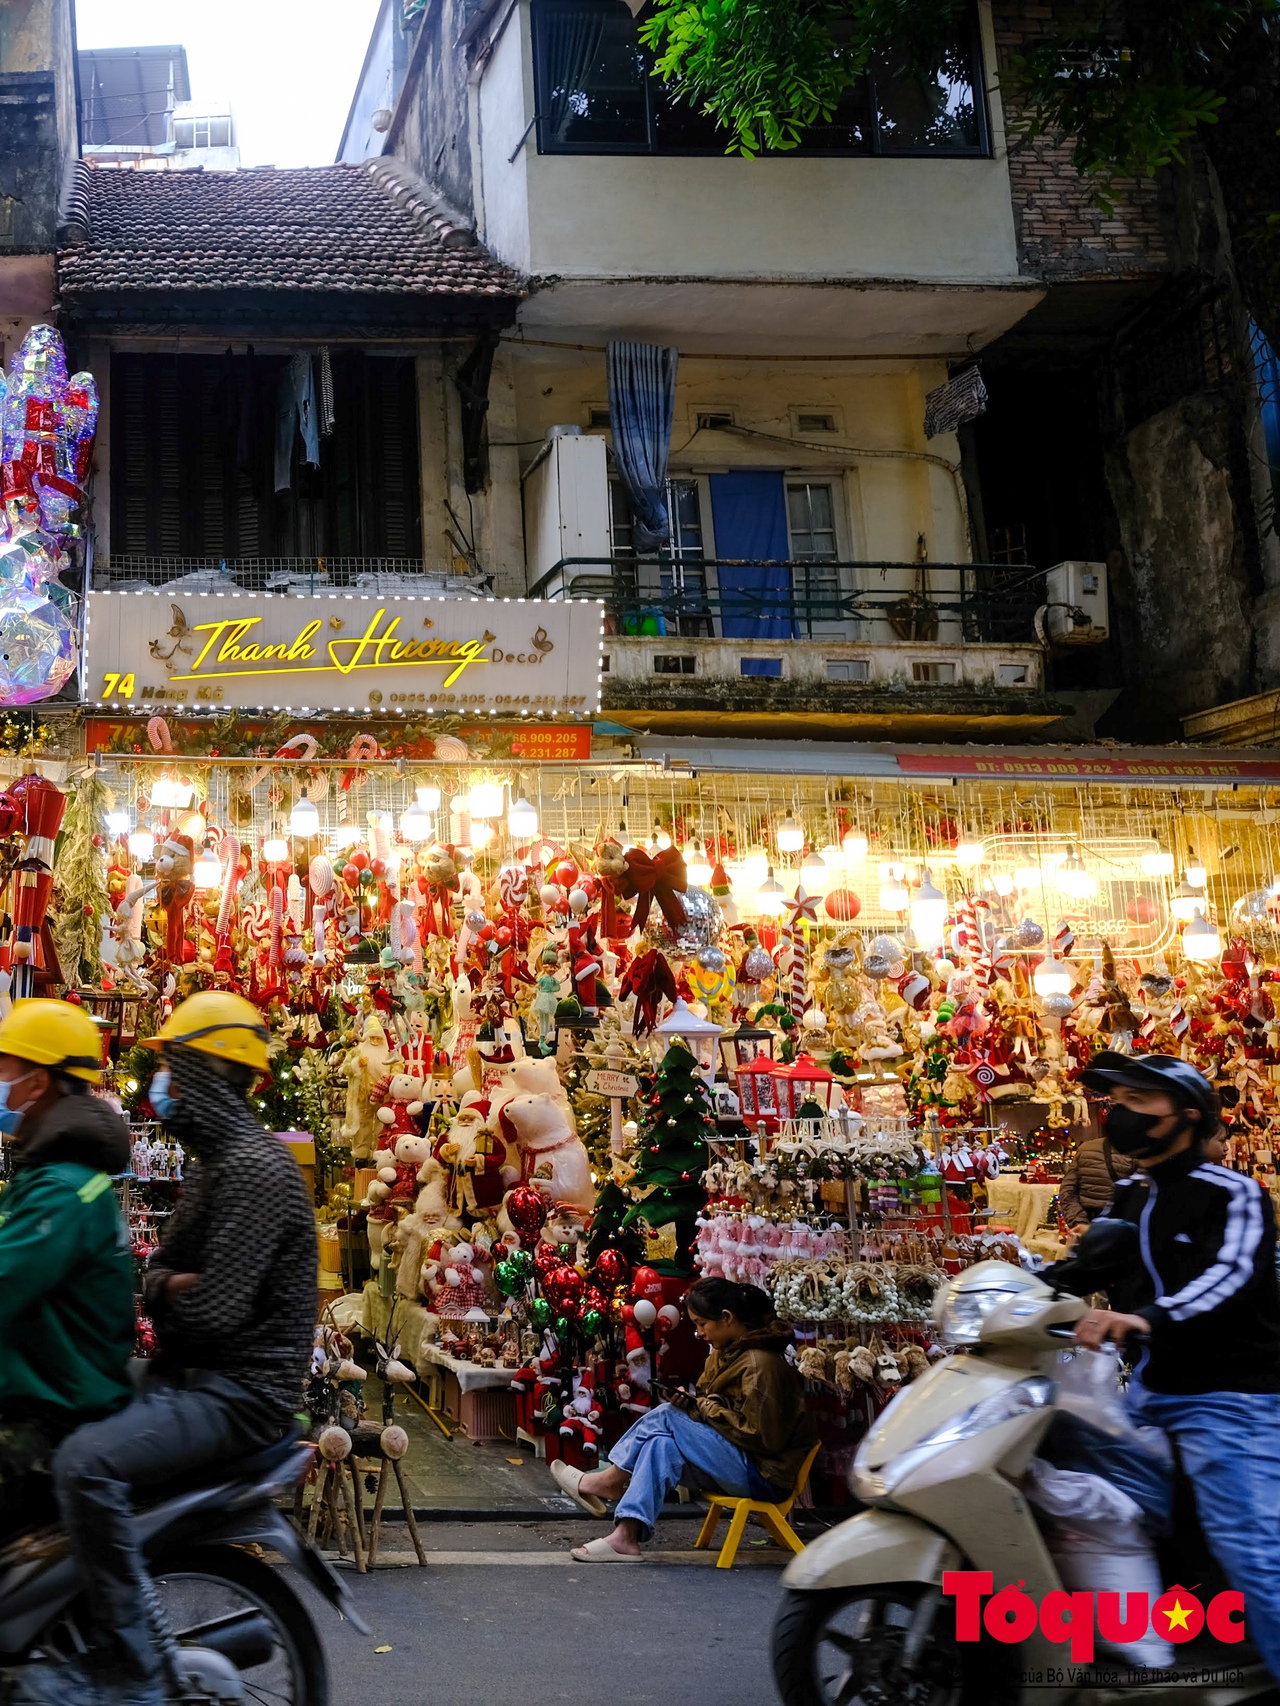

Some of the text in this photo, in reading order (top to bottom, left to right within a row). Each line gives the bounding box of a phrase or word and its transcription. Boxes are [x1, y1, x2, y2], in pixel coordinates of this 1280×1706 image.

[191, 616, 323, 671] Thanh
[492, 648, 546, 665] Decor
[102, 673, 136, 699] 74
[141, 685, 188, 702] Hàng
[1003, 763, 1042, 773] 0913
[1082, 764, 1113, 774] 242
[1127, 765, 1170, 775] 0988
[596, 1072, 619, 1082] MERRY
[602, 1082, 629, 1092] Christmas
